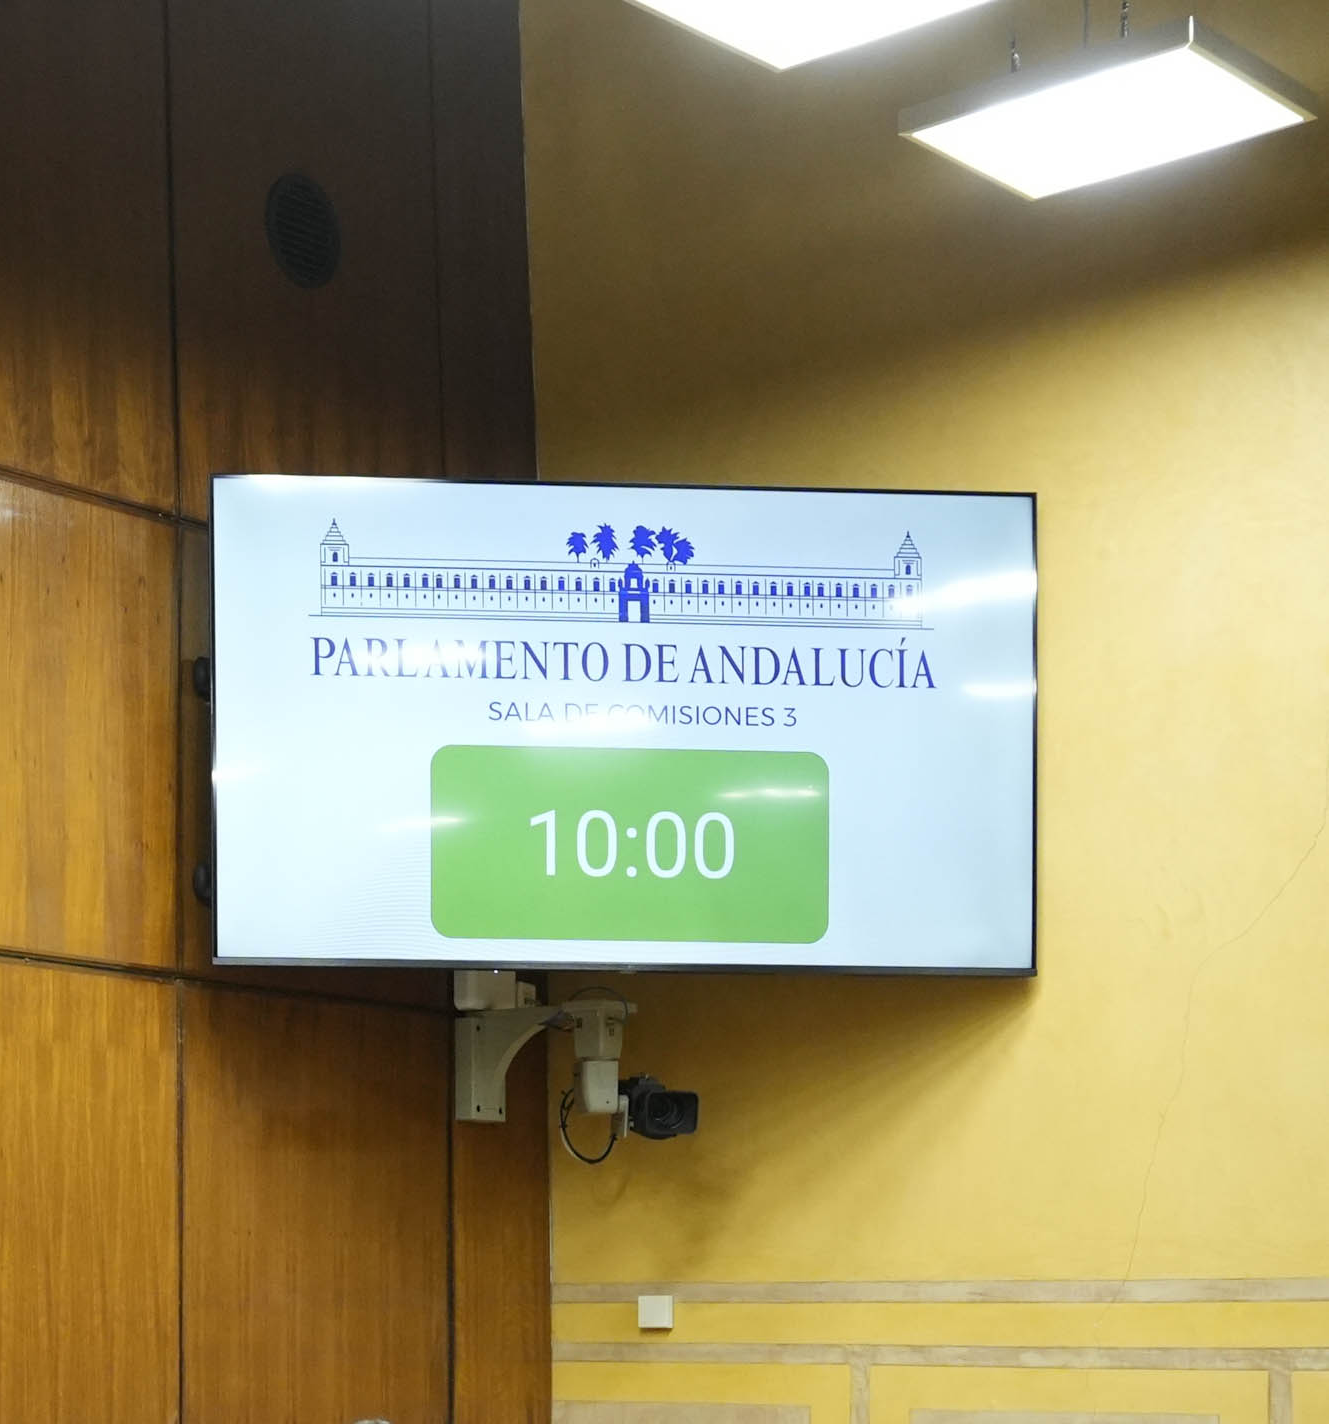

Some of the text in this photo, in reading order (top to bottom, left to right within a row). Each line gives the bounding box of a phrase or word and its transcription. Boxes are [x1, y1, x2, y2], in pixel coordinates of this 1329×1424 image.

[309, 637, 937, 689] PARLAMENTO DE ANDALUCÍA
[488, 701, 555, 723] SALA
[783, 707, 798, 727] 3
[529, 809, 735, 879] 10:00
